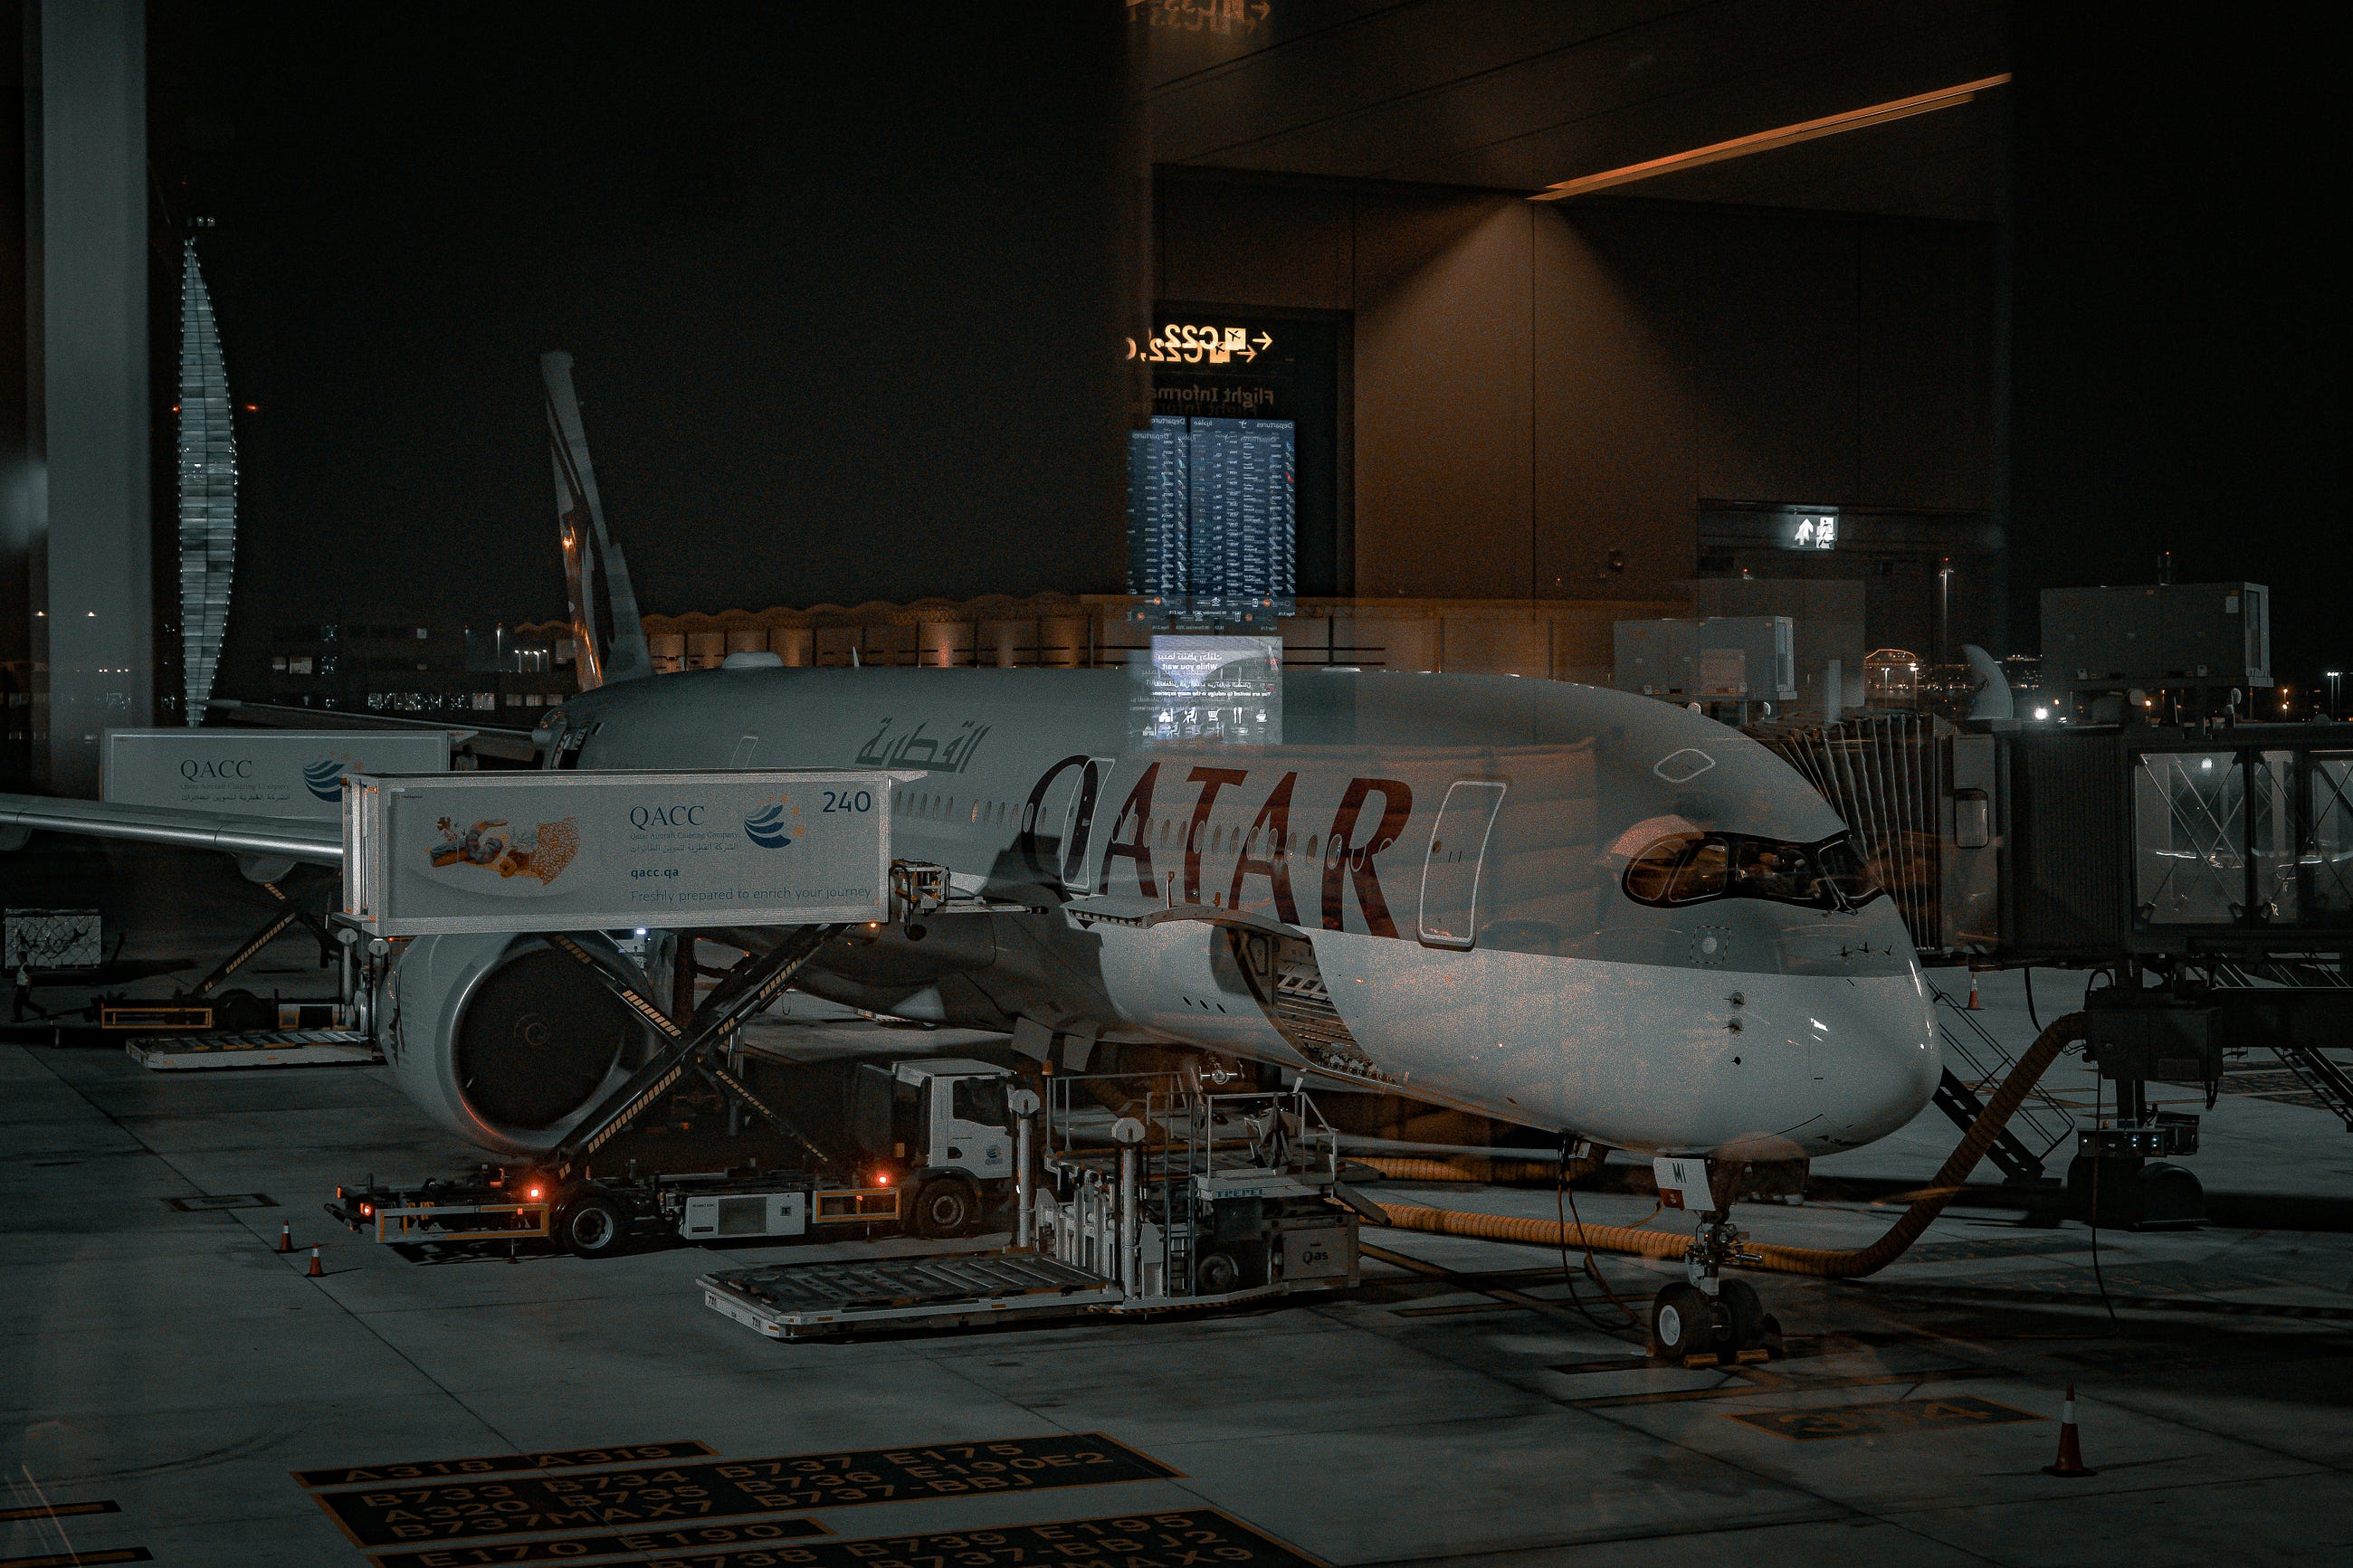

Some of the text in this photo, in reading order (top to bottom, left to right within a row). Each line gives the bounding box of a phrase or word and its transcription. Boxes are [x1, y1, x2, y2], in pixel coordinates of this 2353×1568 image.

[854, 717, 992, 774] القطرية
[181, 759, 252, 783] QACC
[630, 805, 705, 831] QACC
[823, 790, 872, 813] 240
[1021, 755, 1414, 939] QATAR
[631, 868, 679, 880] qacc.qa
[631, 887, 872, 903] Freshly prepared to enrich your journey
[343, 1446, 672, 1482] A318 A319
[361, 1444, 1024, 1508] B733 B734 B737 E175
[383, 1451, 1114, 1524] A320 B735 B736 E190E2
[417, 1525, 784, 1567] E170 E190
[843, 1532, 1006, 1557] B739
[1027, 1515, 1195, 1539] E195
